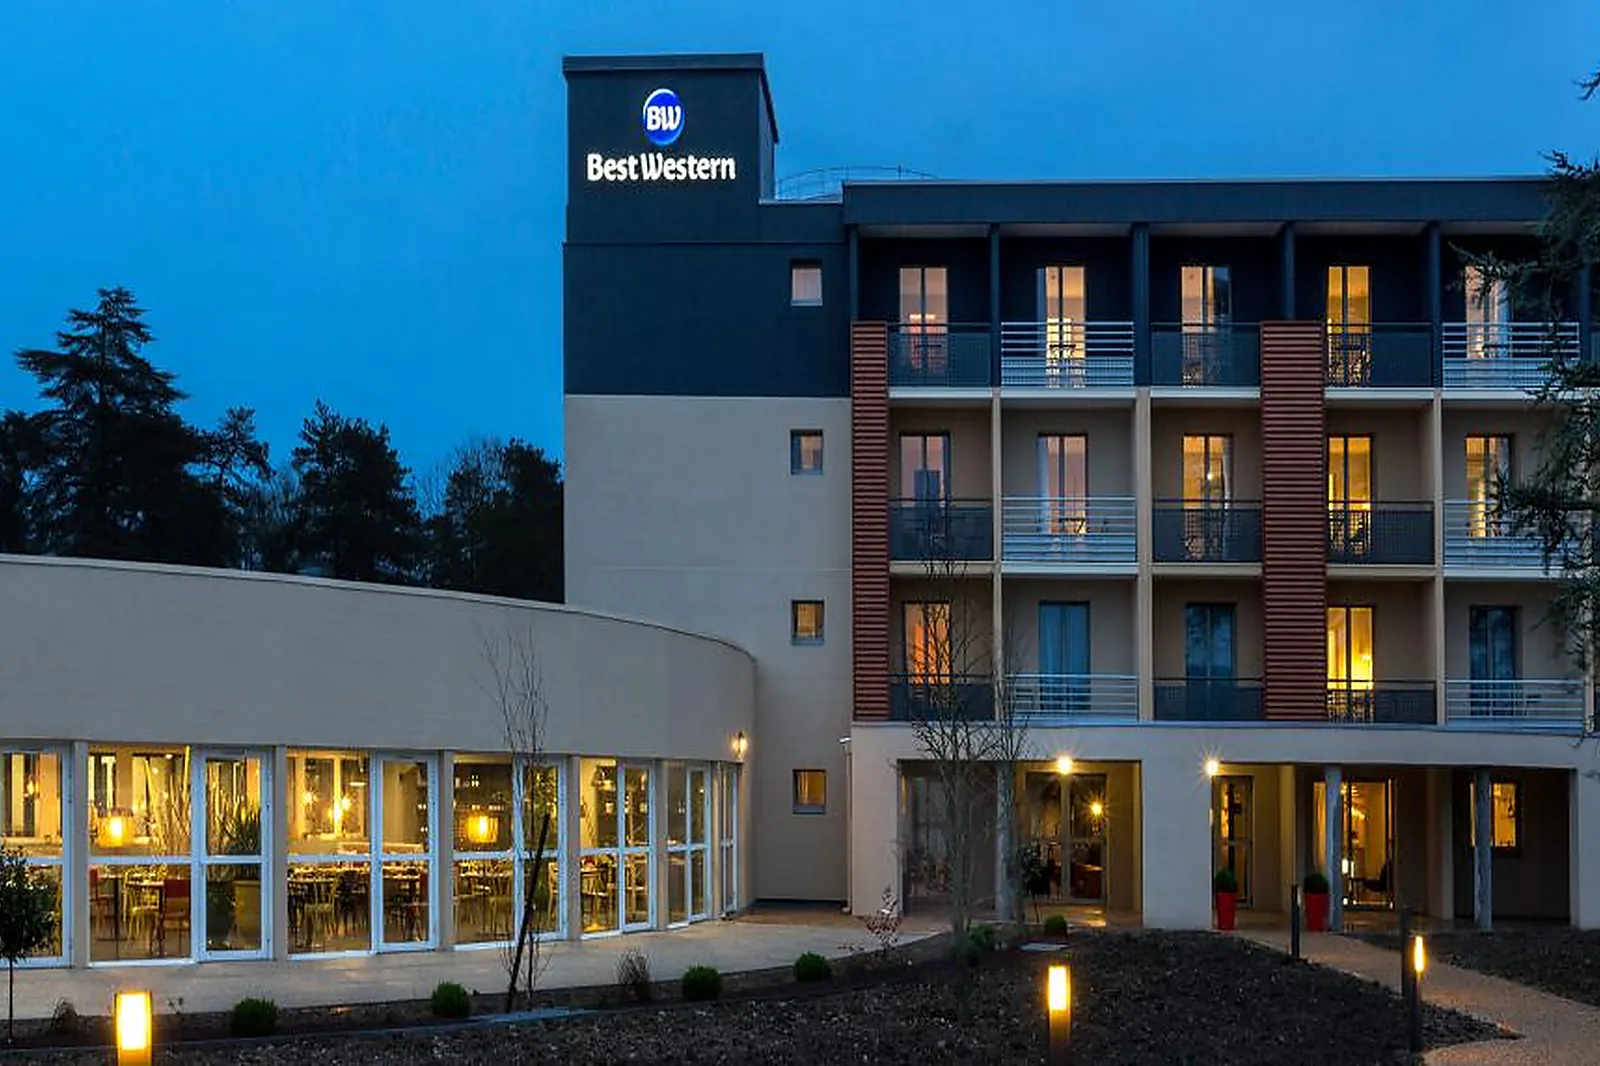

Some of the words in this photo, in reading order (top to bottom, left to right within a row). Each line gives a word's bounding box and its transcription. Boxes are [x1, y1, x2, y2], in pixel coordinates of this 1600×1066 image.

[647, 105, 681, 131] BW
[587, 153, 638, 181] Best
[640, 152, 736, 181] Western
